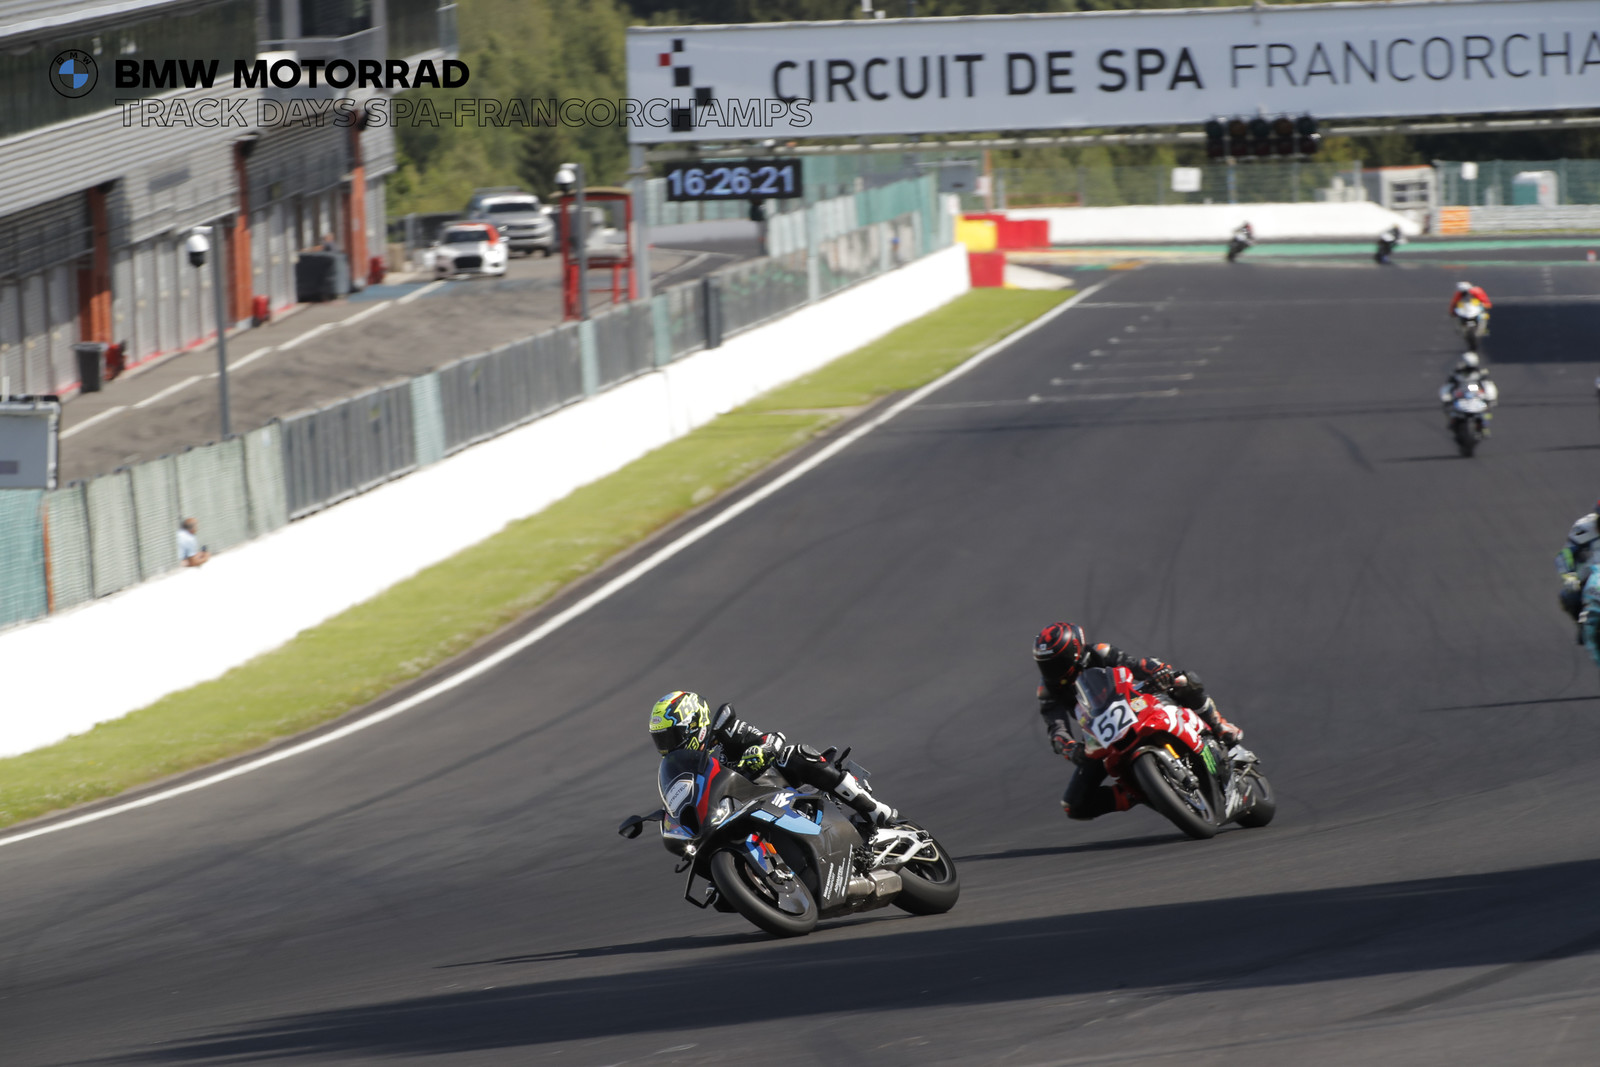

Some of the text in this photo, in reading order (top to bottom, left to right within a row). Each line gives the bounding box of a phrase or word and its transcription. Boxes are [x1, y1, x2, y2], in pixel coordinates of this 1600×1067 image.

[773, 31, 1600, 103] CIRCUIT DE SPA FRANCORCHA
[667, 165, 795, 196] 16:26:21
[1098, 705, 1133, 742] 52
